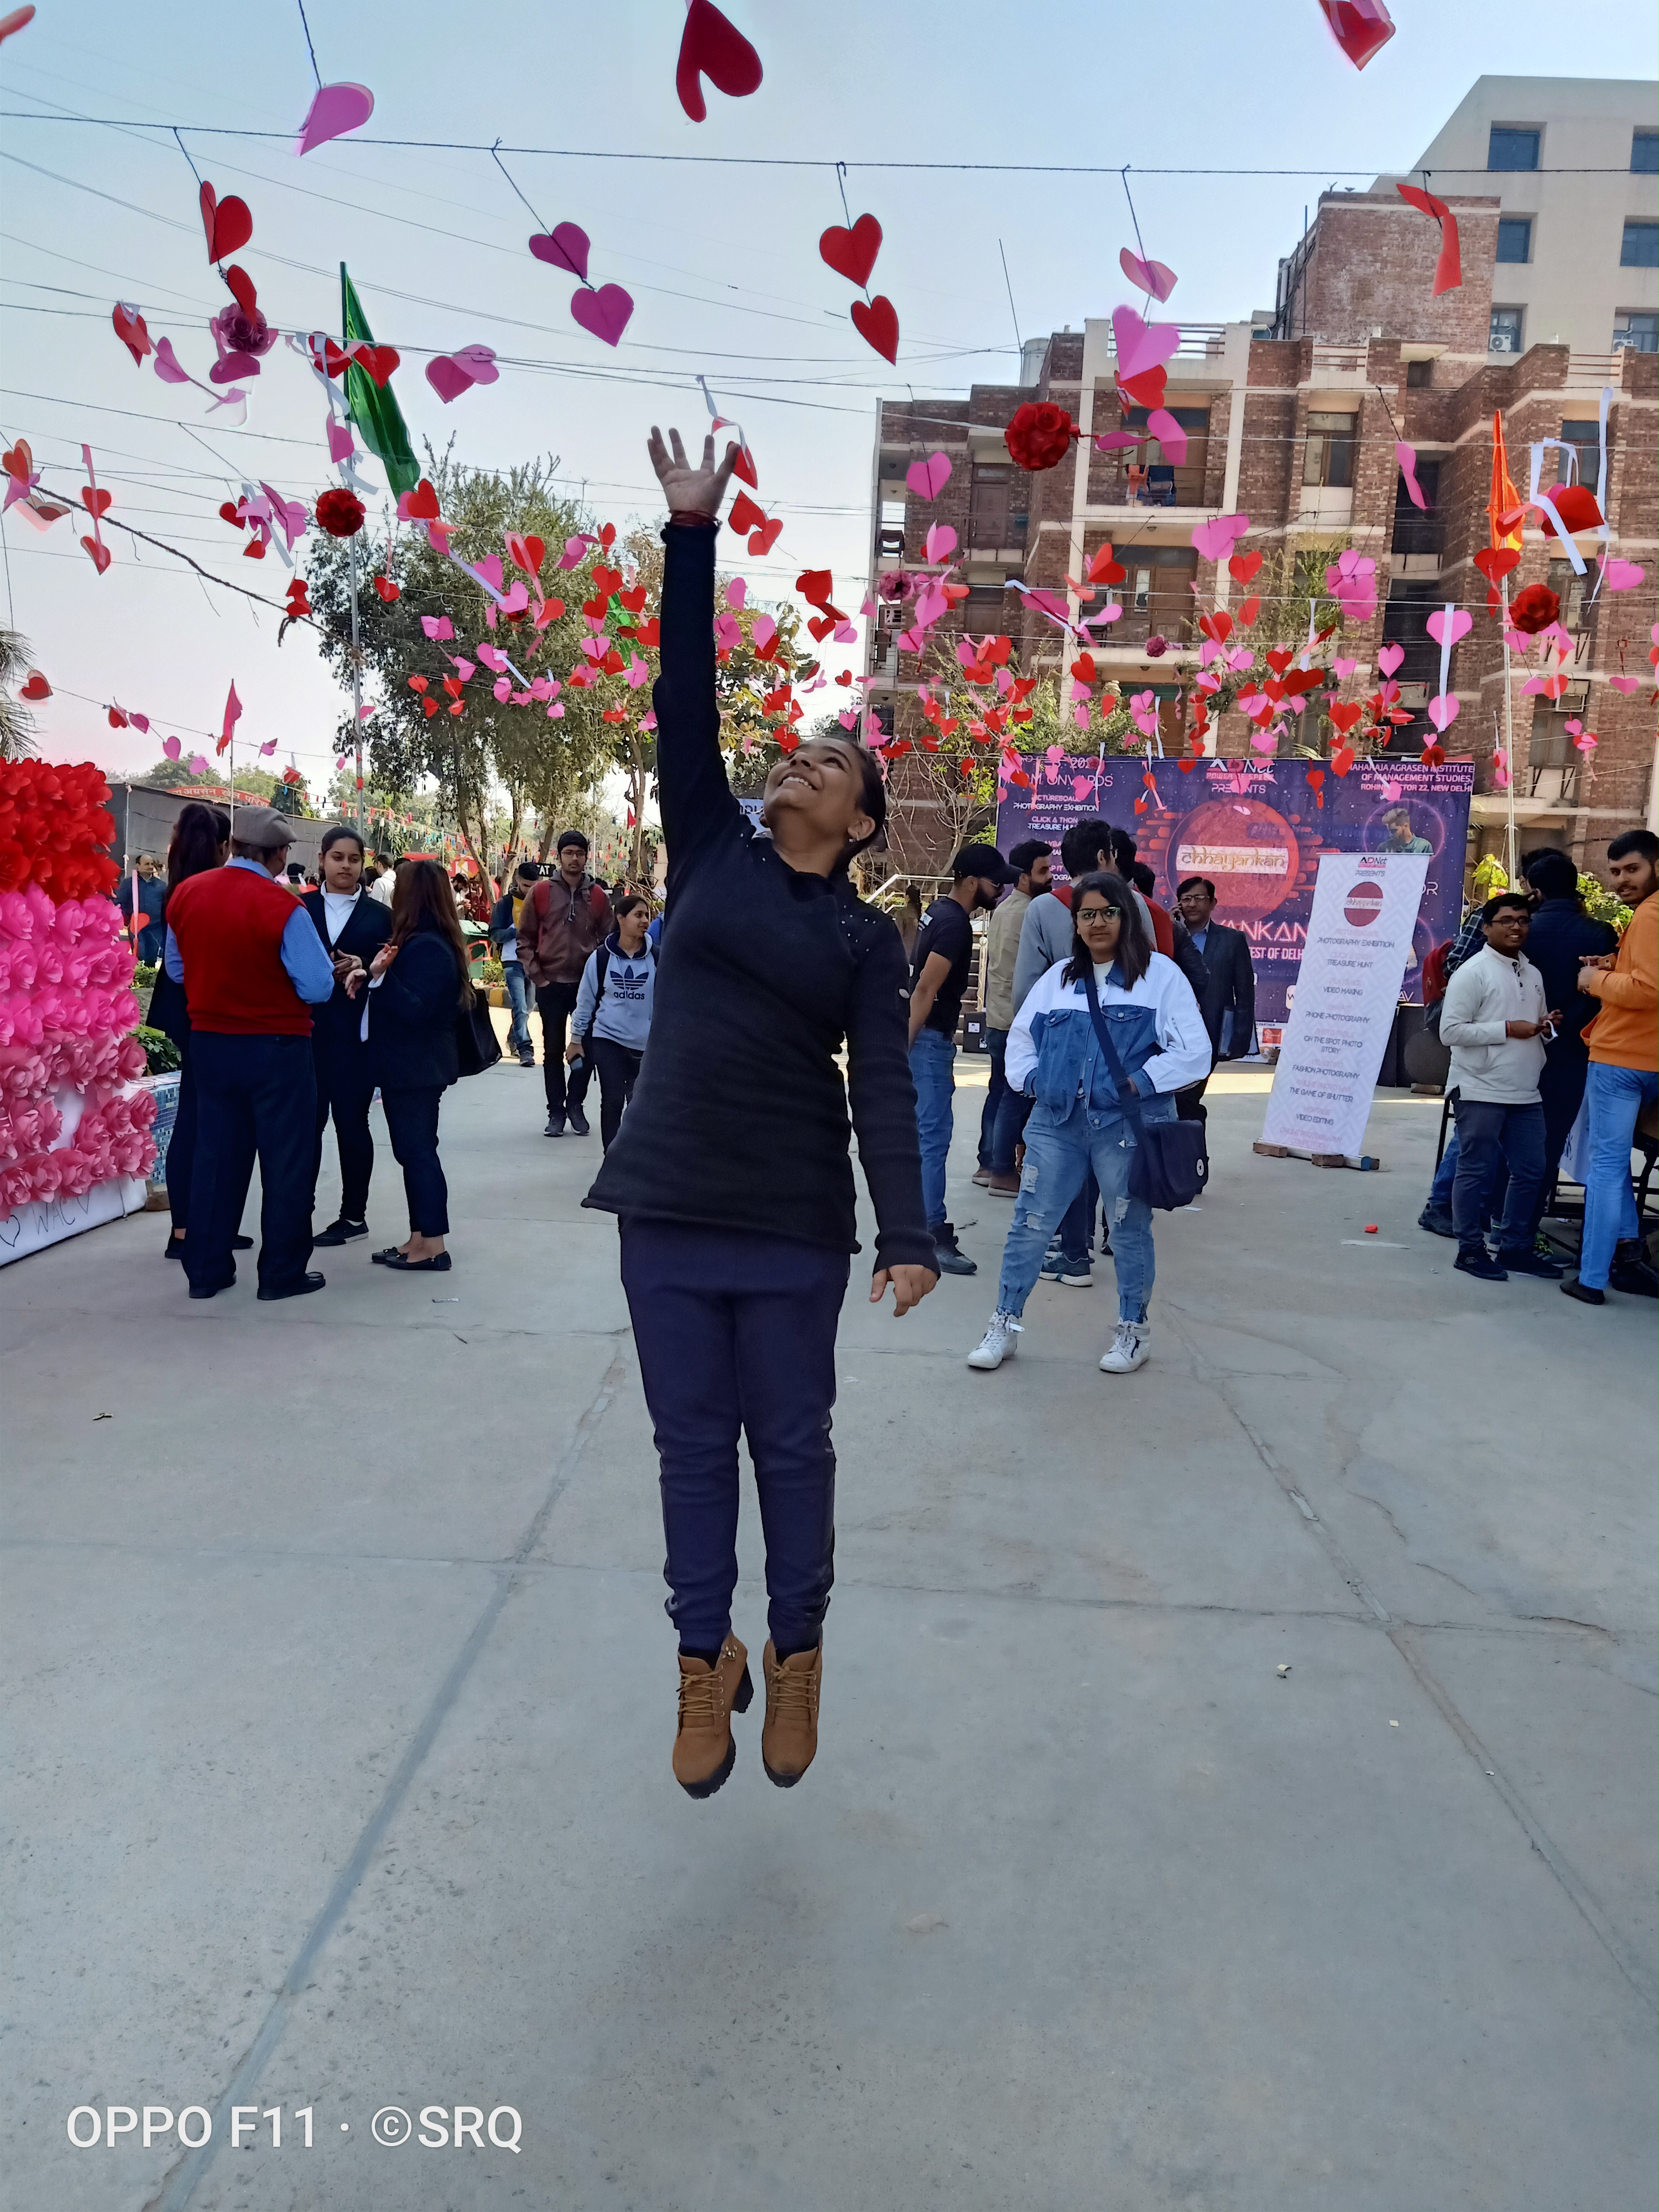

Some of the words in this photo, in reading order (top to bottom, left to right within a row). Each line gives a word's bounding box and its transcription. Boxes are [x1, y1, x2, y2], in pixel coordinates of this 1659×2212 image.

[1390, 764, 1429, 773] AGRASEN
[1374, 773, 1434, 781] MANAGEMENT
[1435, 775, 1473, 783] STUDIES,
[183, 786, 216, 795] अग्रसेन
[1211, 783, 1266, 794] PRENTS
[1013, 802, 1063, 811] PHOTGRAPHY
[1063, 803, 1099, 812] EXHIBITION
[1028, 822, 1062, 831] TREASURE
[1181, 846, 1285, 872] chhayankan
[1317, 937, 1360, 946] PHOTOGRAPHY
[1361, 940, 1395, 948] EXHIBITION
[1267, 947, 1281, 960] OF
[1327, 959, 1357, 967] TREASURE
[613, 991, 645, 1000] adidas
[1340, 988, 1363, 996] MAKING
[1305, 1011, 1325, 1019] PHONE
[1325, 1013, 1370, 1024] PHOTOGRAPHY
[1314, 1036, 1325, 1044] THE
[1342, 1039, 1363, 1048] PHOTO
[1321, 1046, 1341, 1054] STORY
[1292, 1065, 1316, 1074] FASHION
[1316, 1068, 1360, 1079] PHOTOGRAPHY
[1290, 1087, 1301, 1095] THE
[1301, 1089, 1317, 1097] GAME
[1327, 1093, 1354, 1103] SHUTTER
[1296, 1113, 1312, 1122] VIDEO
[1312, 1116, 1334, 1125] EDITING
